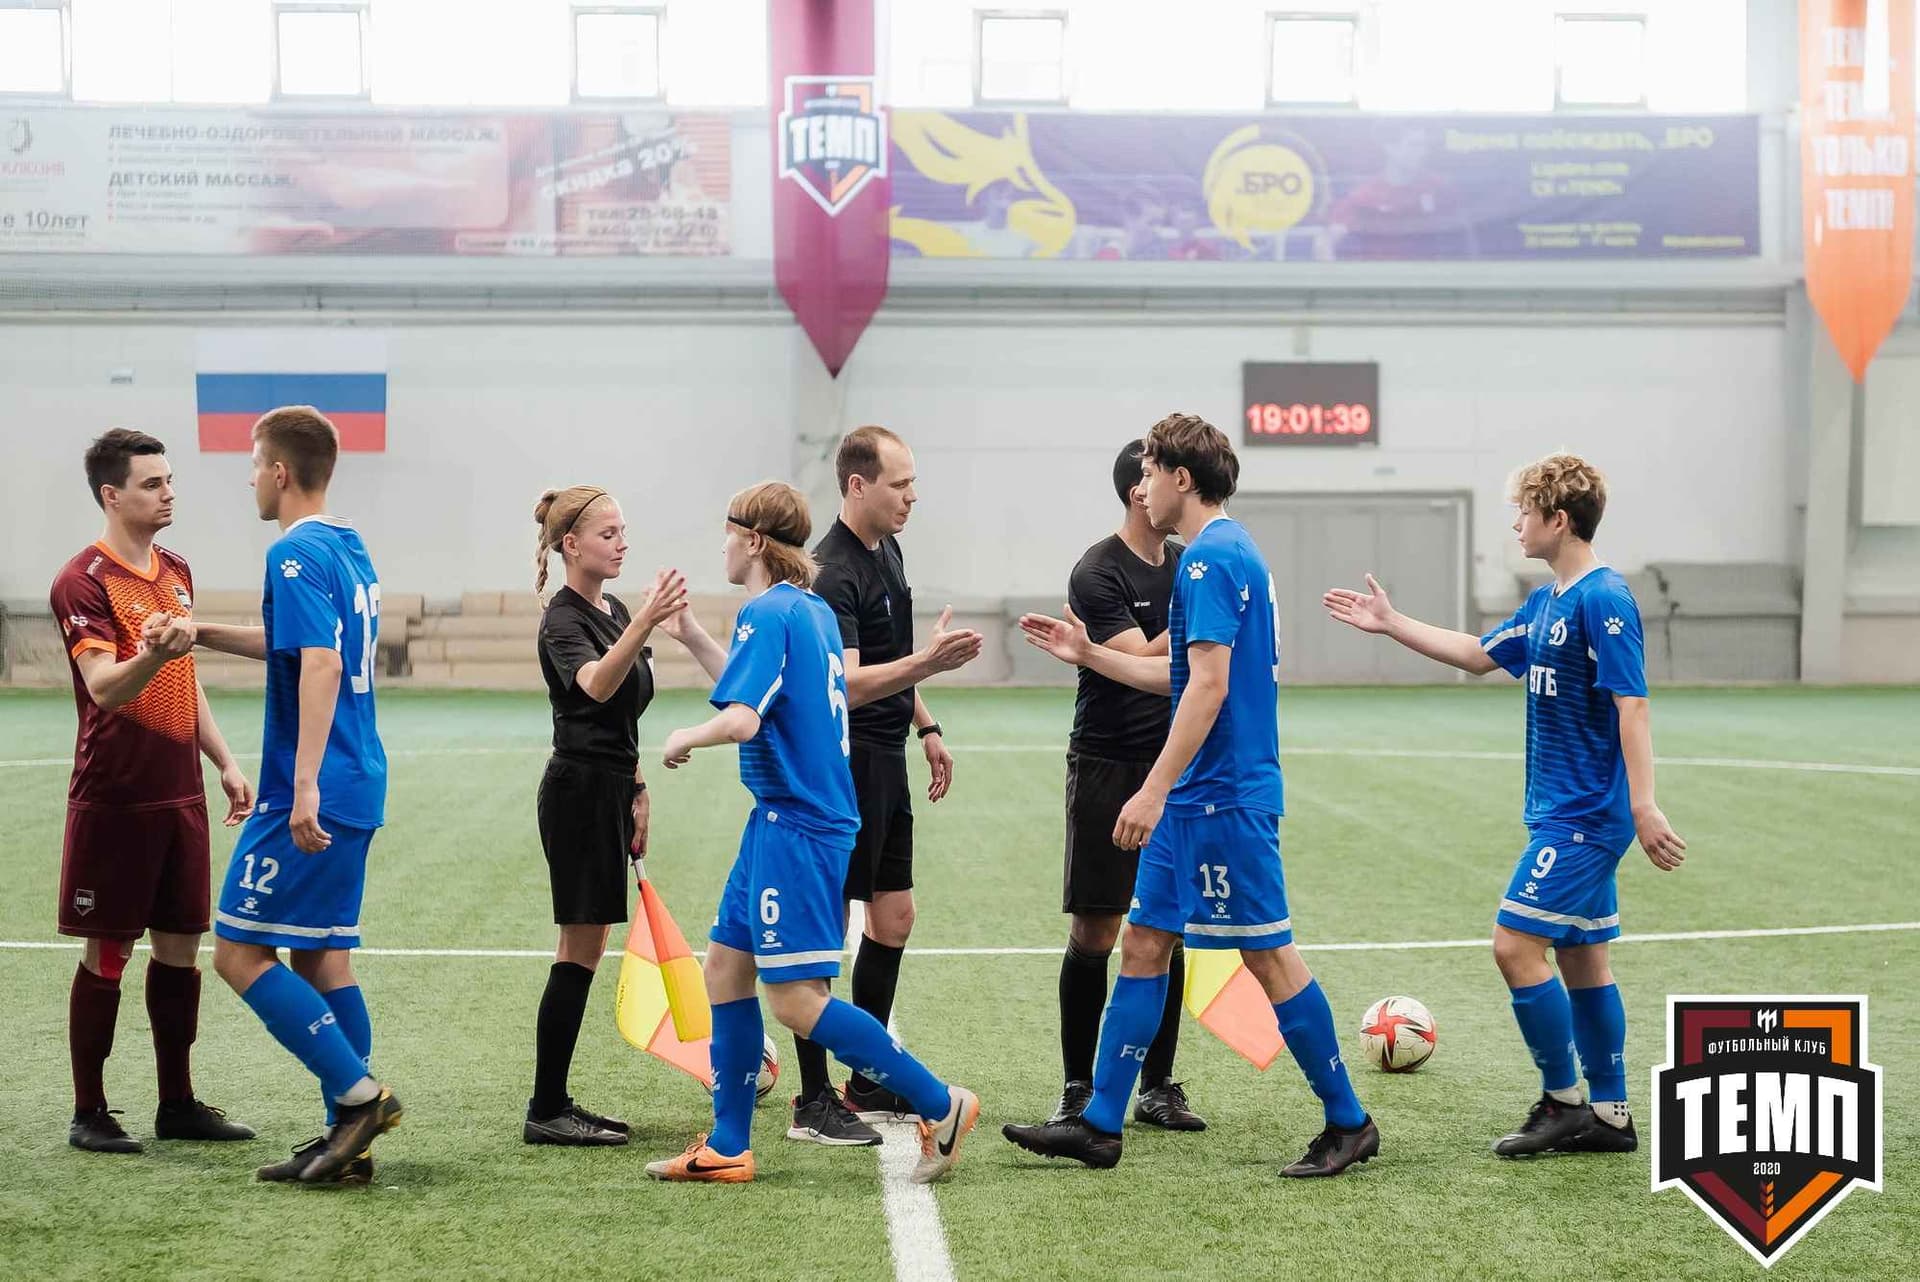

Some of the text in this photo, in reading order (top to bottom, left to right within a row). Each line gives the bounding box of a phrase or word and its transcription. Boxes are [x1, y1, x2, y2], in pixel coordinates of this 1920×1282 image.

[788, 115, 878, 163] ТЕМП
[1811, 134, 1908, 176] ТОЛЬКО
[109, 170, 199, 187] ДЕТСКИЙ
[1247, 402, 1371, 435] 19:01:39
[1530, 664, 1557, 697] ВТБ
[239, 853, 280, 894] 12
[1531, 846, 1557, 878] 9
[1199, 863, 1231, 899] 13
[760, 887, 780, 925] 6
